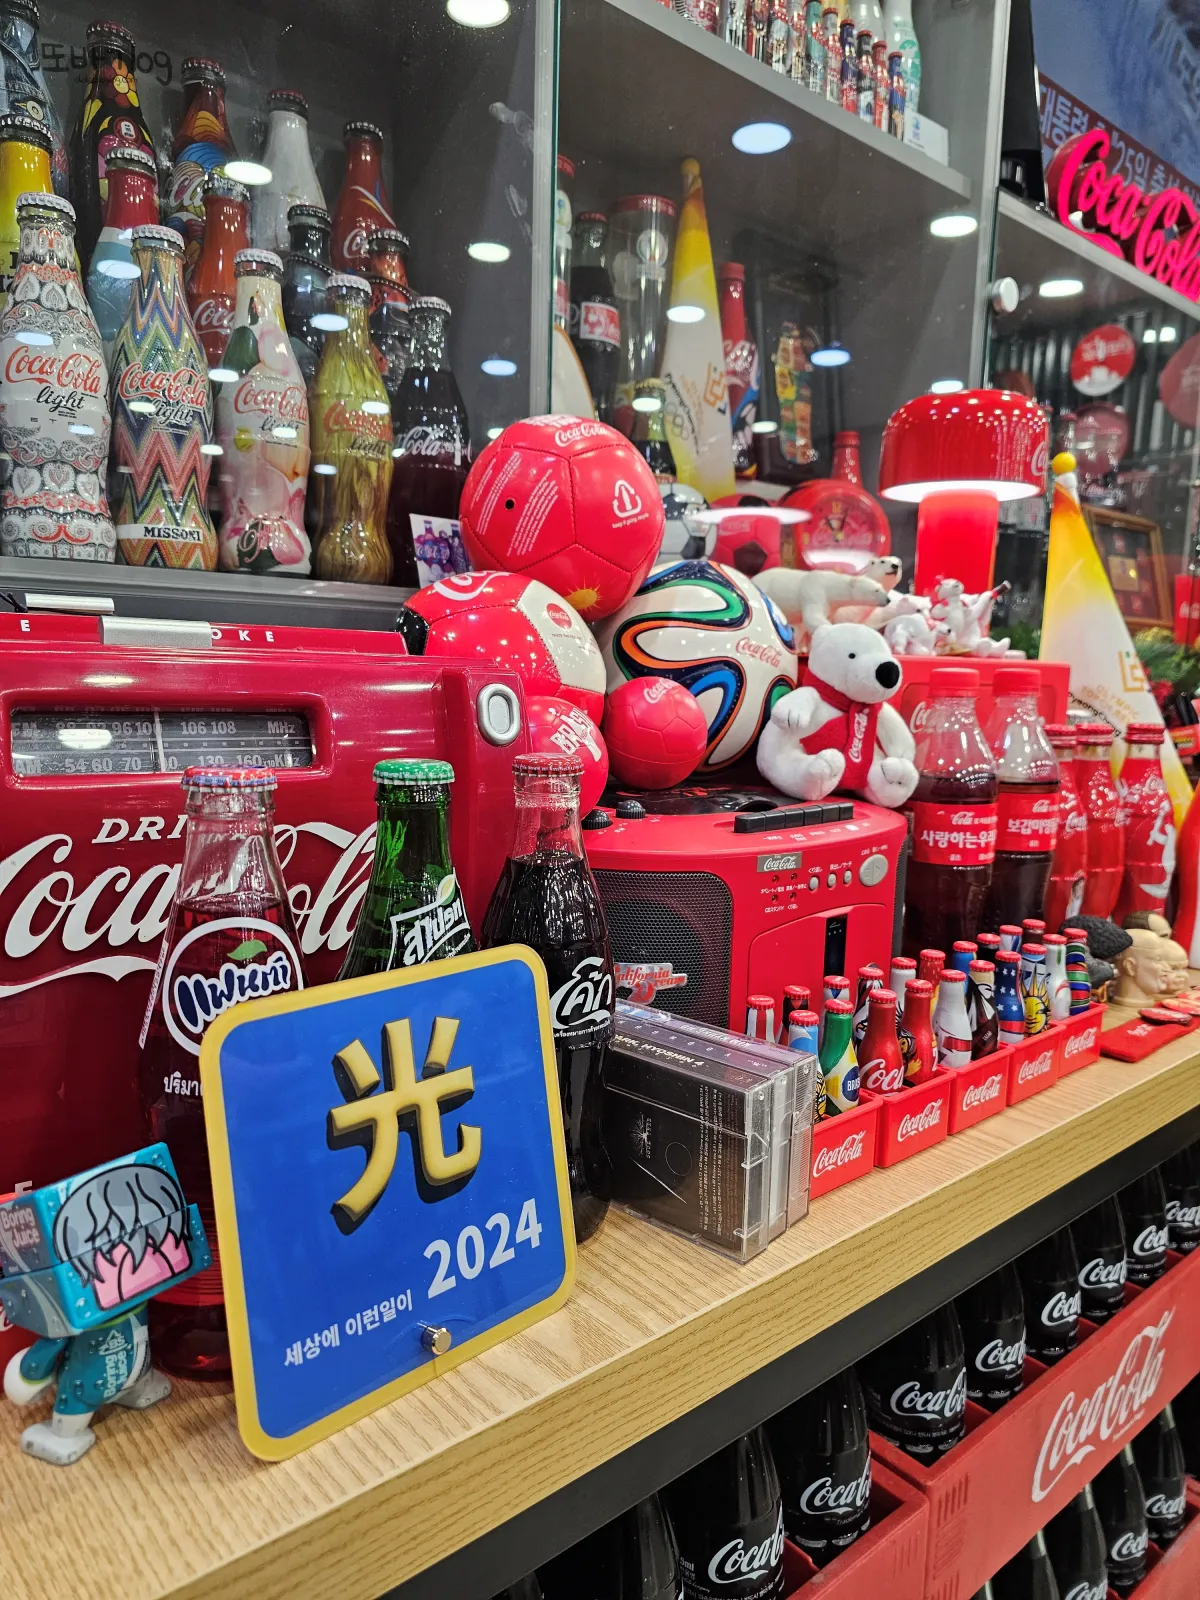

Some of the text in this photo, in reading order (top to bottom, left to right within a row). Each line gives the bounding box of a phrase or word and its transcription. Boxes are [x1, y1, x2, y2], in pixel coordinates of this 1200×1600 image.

[36, 385, 85, 413] light
[144, 526, 202, 542] MISSONI
[112, 722, 133, 736] 96
[181, 722, 207, 734] 106
[211, 721, 236, 734] 108
[268, 721, 295, 734] MHz
[16, 759, 42, 773] AM
[65, 759, 85, 772] 54
[92, 758, 112, 772] 60
[122, 757, 142, 771] 70
[329, 1016, 482, 1224] 光
[1, 1207, 36, 1230] Boring
[13, 1225, 40, 1248] Juice
[423, 1198, 543, 1299] 2024
[283, 1288, 413, 1367] 세상에 이런일이
